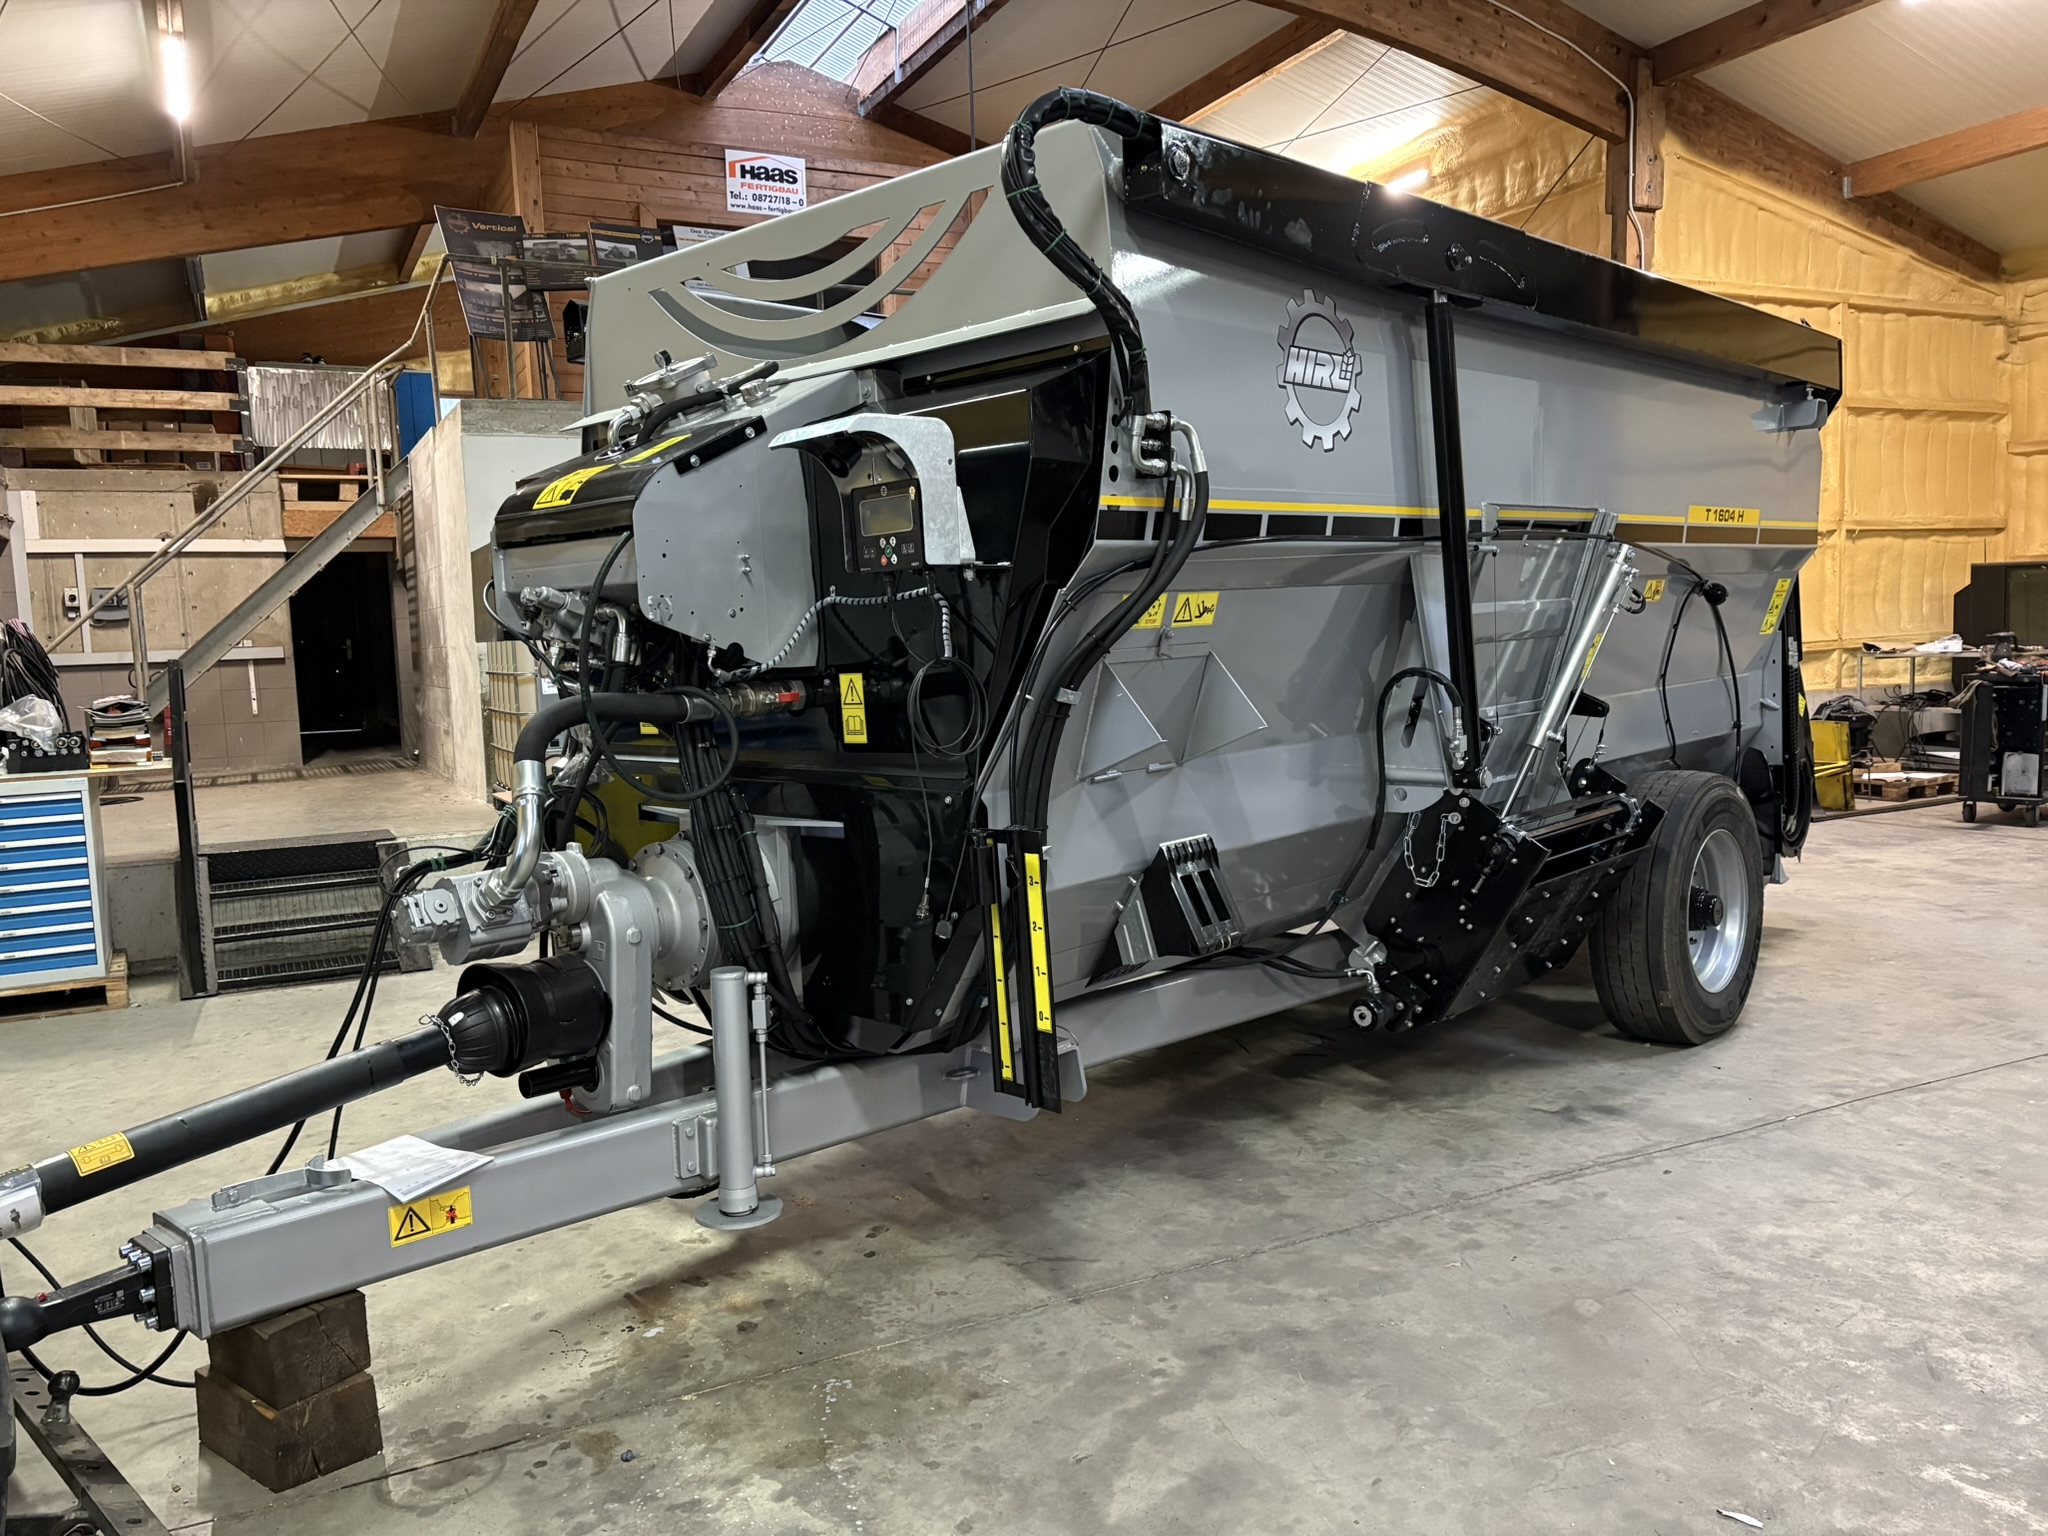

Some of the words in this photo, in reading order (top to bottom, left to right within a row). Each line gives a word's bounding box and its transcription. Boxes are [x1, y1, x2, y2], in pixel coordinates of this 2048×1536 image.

[740, 164, 798, 185] Haas
[740, 182, 799, 195] FERTIGBAU
[729, 191, 748, 201] Tel.:
[471, 222, 517, 232] Vertical
[489, 325, 518, 334] GmH
[1284, 346, 1351, 392] HIRL
[1705, 508, 1711, 521] T
[1713, 509, 1735, 522] 1604
[1737, 510, 1744, 522] H
[1028, 875, 1034, 886] 3
[1032, 921, 1038, 932] 2
[1035, 966, 1041, 977] 1
[1038, 1011, 1044, 1022] 0
